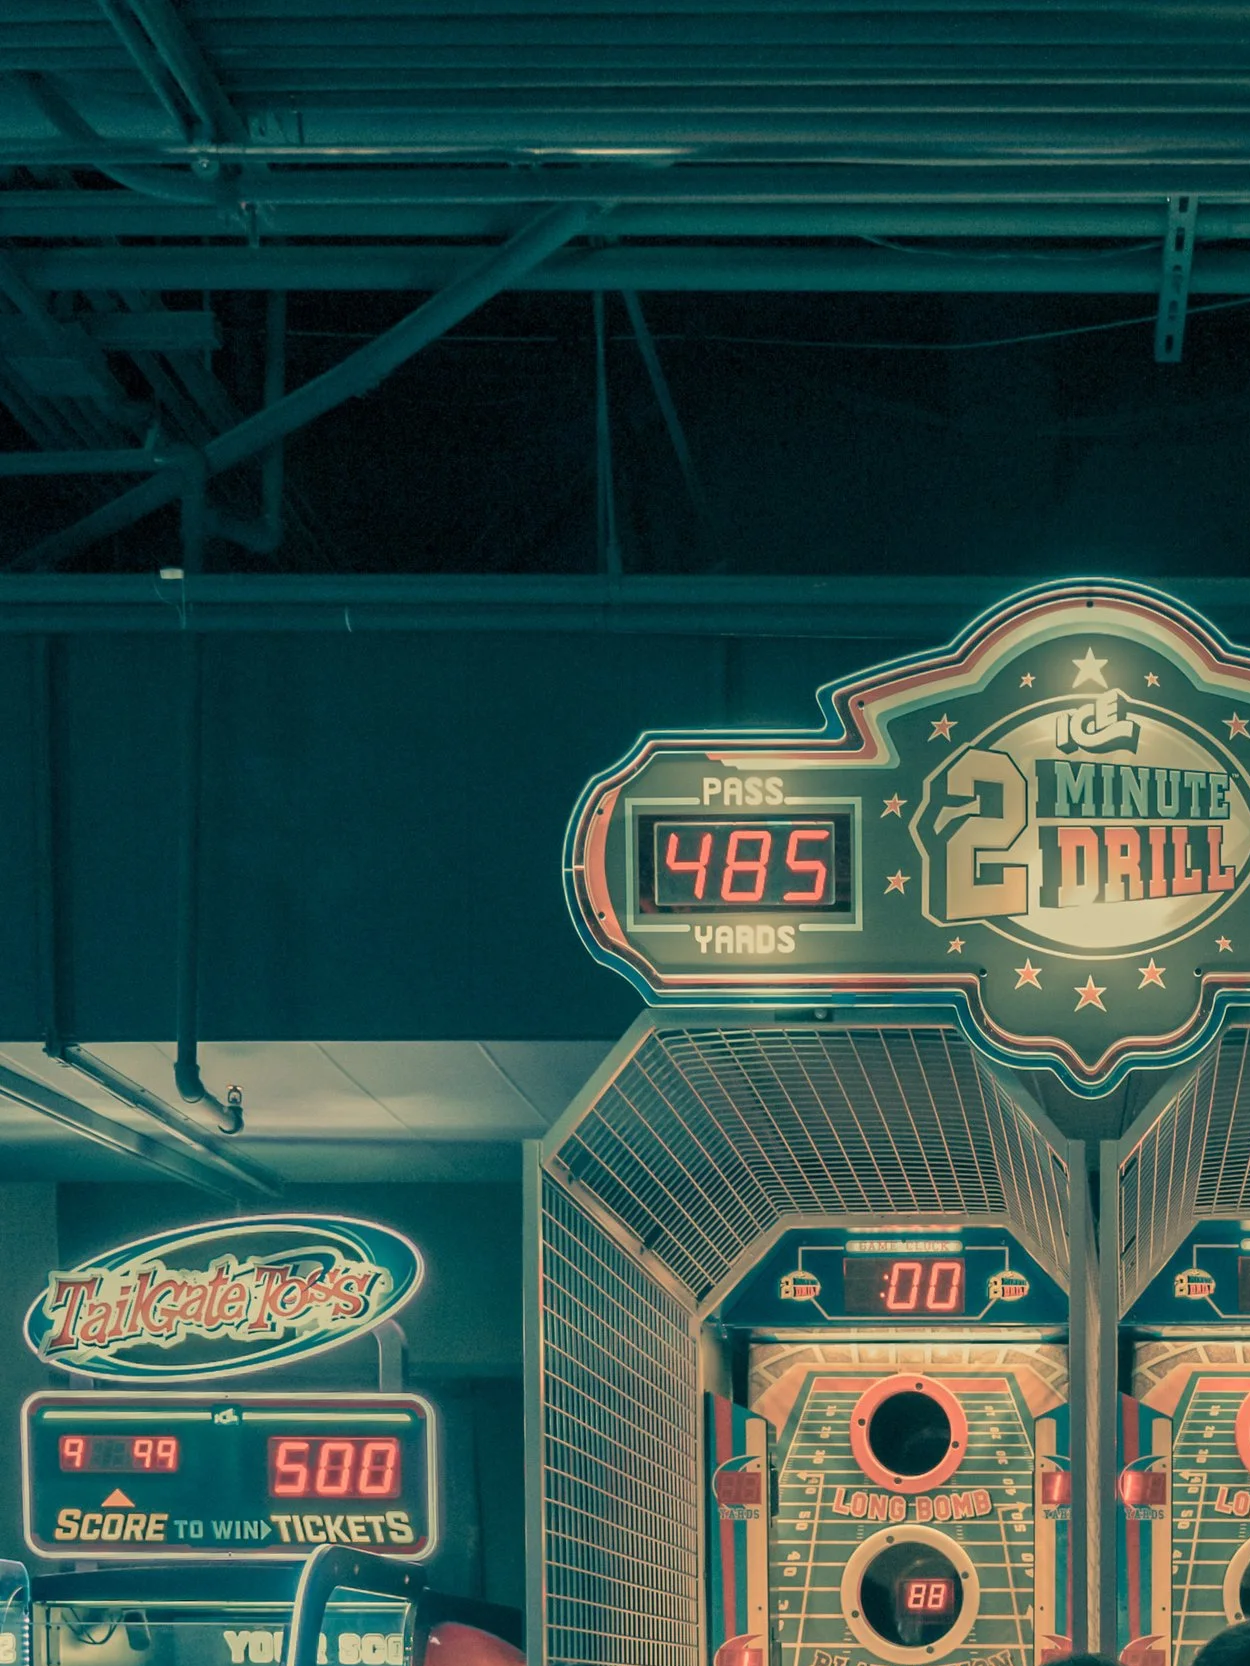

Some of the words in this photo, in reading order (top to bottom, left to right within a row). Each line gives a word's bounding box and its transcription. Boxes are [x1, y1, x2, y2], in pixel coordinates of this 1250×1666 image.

[1056, 688, 1139, 752] ICE
[702, 775, 785, 807] PASS
[1053, 760, 1231, 819] MINUTE
[934, 749, 1029, 921] 2
[665, 829, 831, 903] 485
[1057, 825, 1236, 907] DRILL
[693, 923, 797, 956] YARDS
[62, 1438, 85, 1469] 9
[132, 1438, 177, 1469] 99
[274, 1442, 399, 1494] 500
[832, 1486, 907, 1522] LONG
[915, 1488, 992, 1522] BOMB
[1043, 1508, 1071, 1520] YAR
[1125, 1508, 1165, 1520] YARDS
[54, 1508, 168, 1542] SCORE
[174, 1519, 204, 1539] TO
[213, 1520, 261, 1539] WIN
[270, 1510, 414, 1544] TICKETS
[906, 1582, 948, 1610] 88
[338, 1632, 405, 1665] SCO
